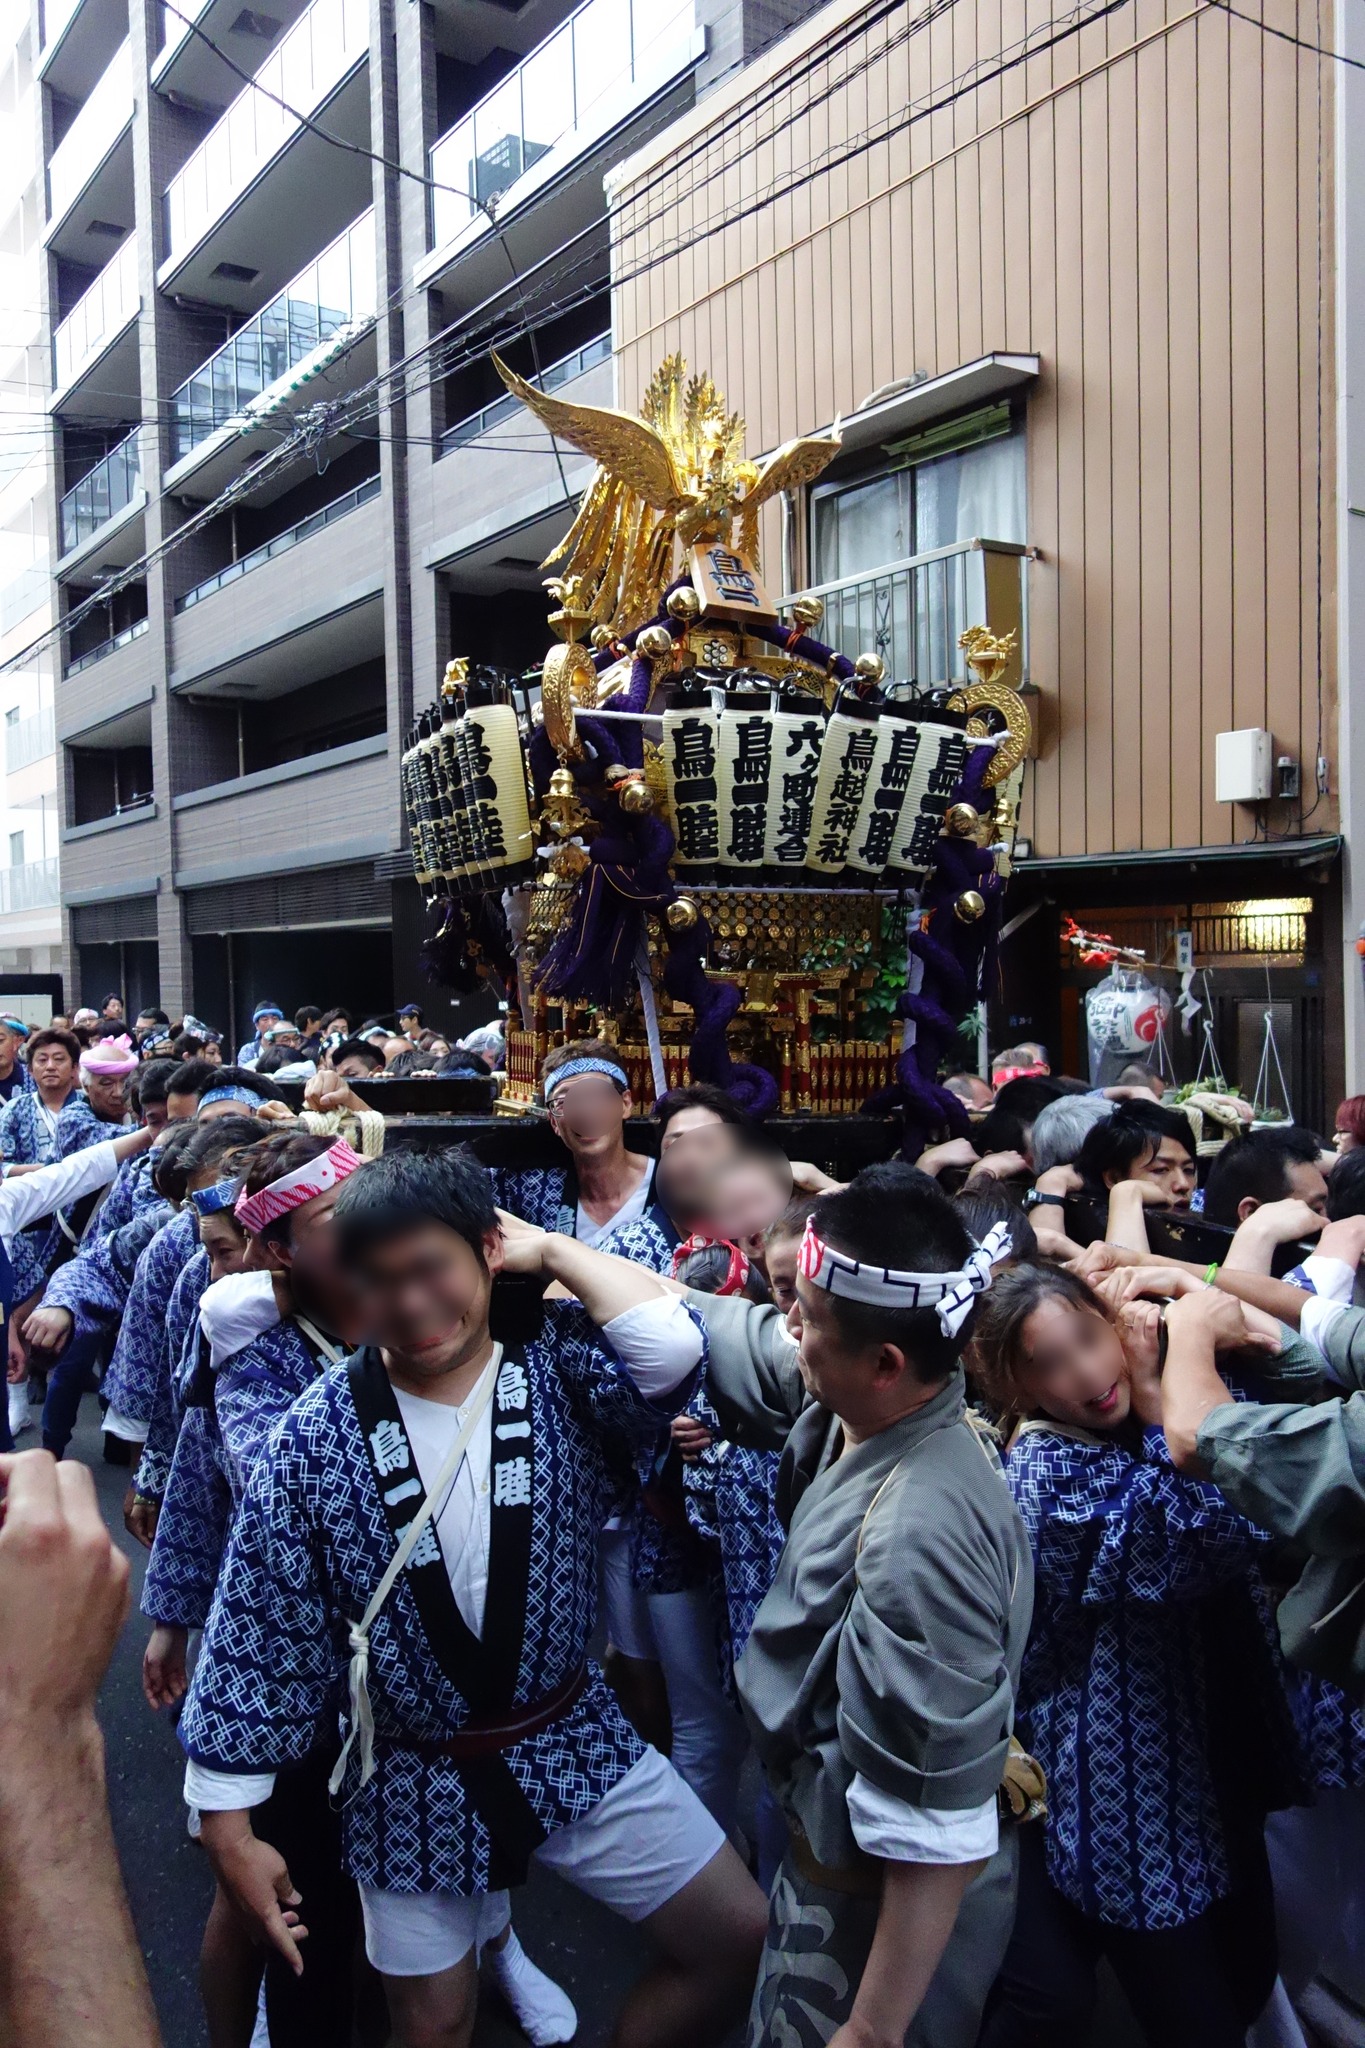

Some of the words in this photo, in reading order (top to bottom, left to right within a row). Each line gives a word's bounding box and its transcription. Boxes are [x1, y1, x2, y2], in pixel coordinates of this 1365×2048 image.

[671, 717, 719, 860] 鳥一睦
[727, 716, 773, 862] 鳥一睦
[815, 728, 878, 864] 鳥越神社
[494, 1362, 532, 1507] 鳥一睦
